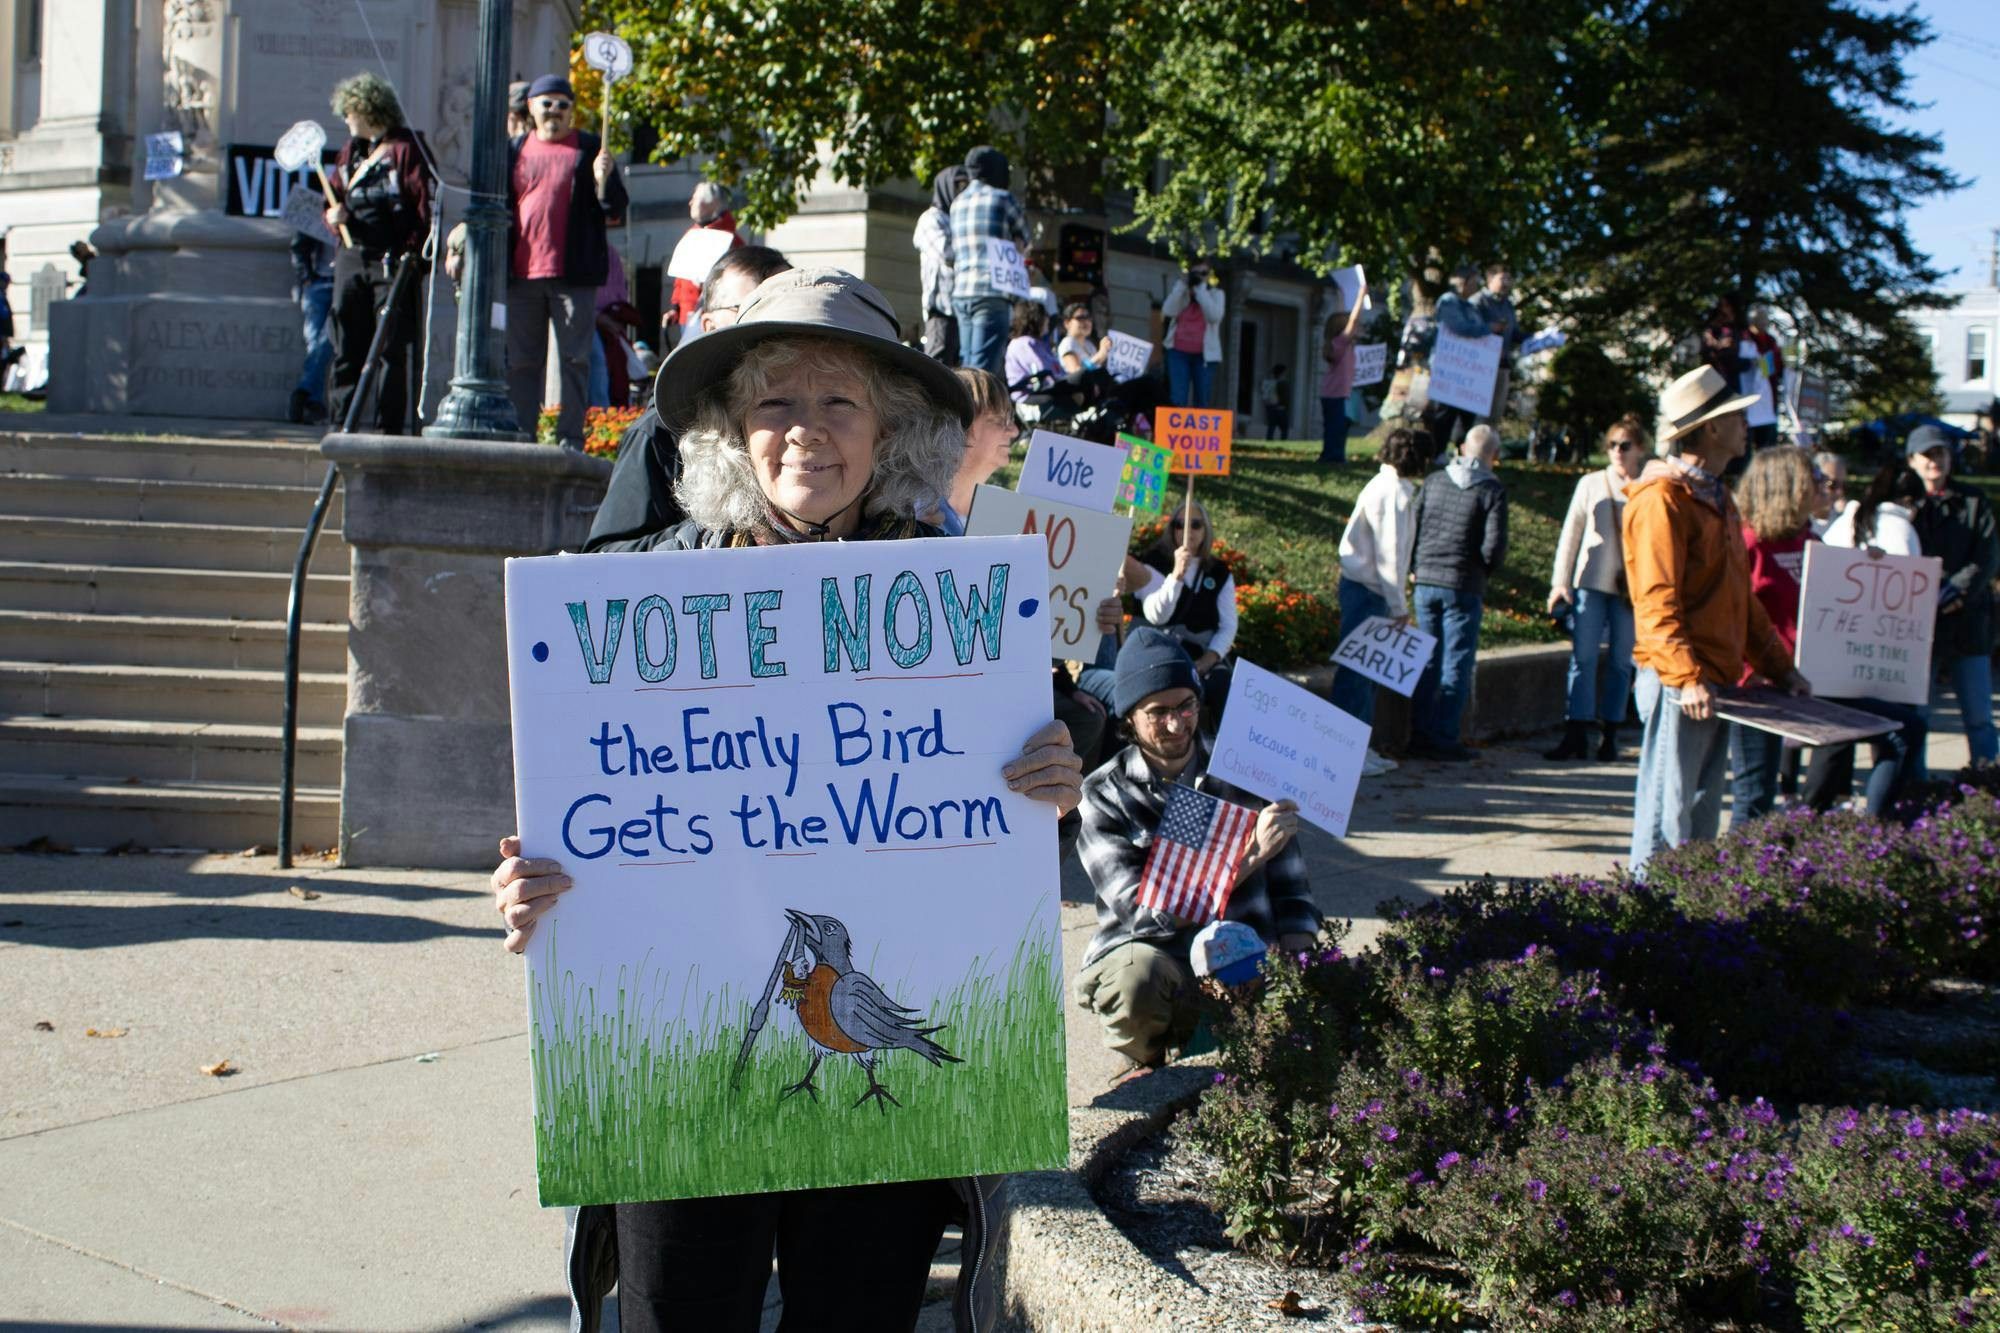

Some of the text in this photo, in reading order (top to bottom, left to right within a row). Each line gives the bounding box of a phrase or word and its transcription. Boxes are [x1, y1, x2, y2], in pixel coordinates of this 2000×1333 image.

[145, 320, 297, 352] ALEXANDER
[1359, 347, 1386, 364] VOTE
[175, 367, 218, 390] THE
[1169, 413, 1223, 431] CAST
[1168, 434, 1221, 451] YOUR
[1047, 446, 1094, 489] Vote
[1121, 463, 1162, 491] OTING
[1172, 454, 1227, 470] ALLOT
[1836, 562, 1929, 614] STOP
[565, 563, 1010, 684] VOTE NOW
[1363, 621, 1423, 659] VOTE
[1816, 607, 1927, 642] THE STEAL
[1339, 640, 1416, 684] EARLY
[1846, 640, 1911, 663] THIS TIME
[1878, 666, 1908, 684] REAL
[1244, 678, 1279, 714] Eggs
[1287, 703, 1308, 723] are
[590, 702, 965, 797] the Early Bird
[1248, 725, 1337, 783] because all the
[1223, 747, 1277, 789] Chickens
[1281, 780, 1298, 797] are
[562, 772, 1011, 861] Gets the Worm
